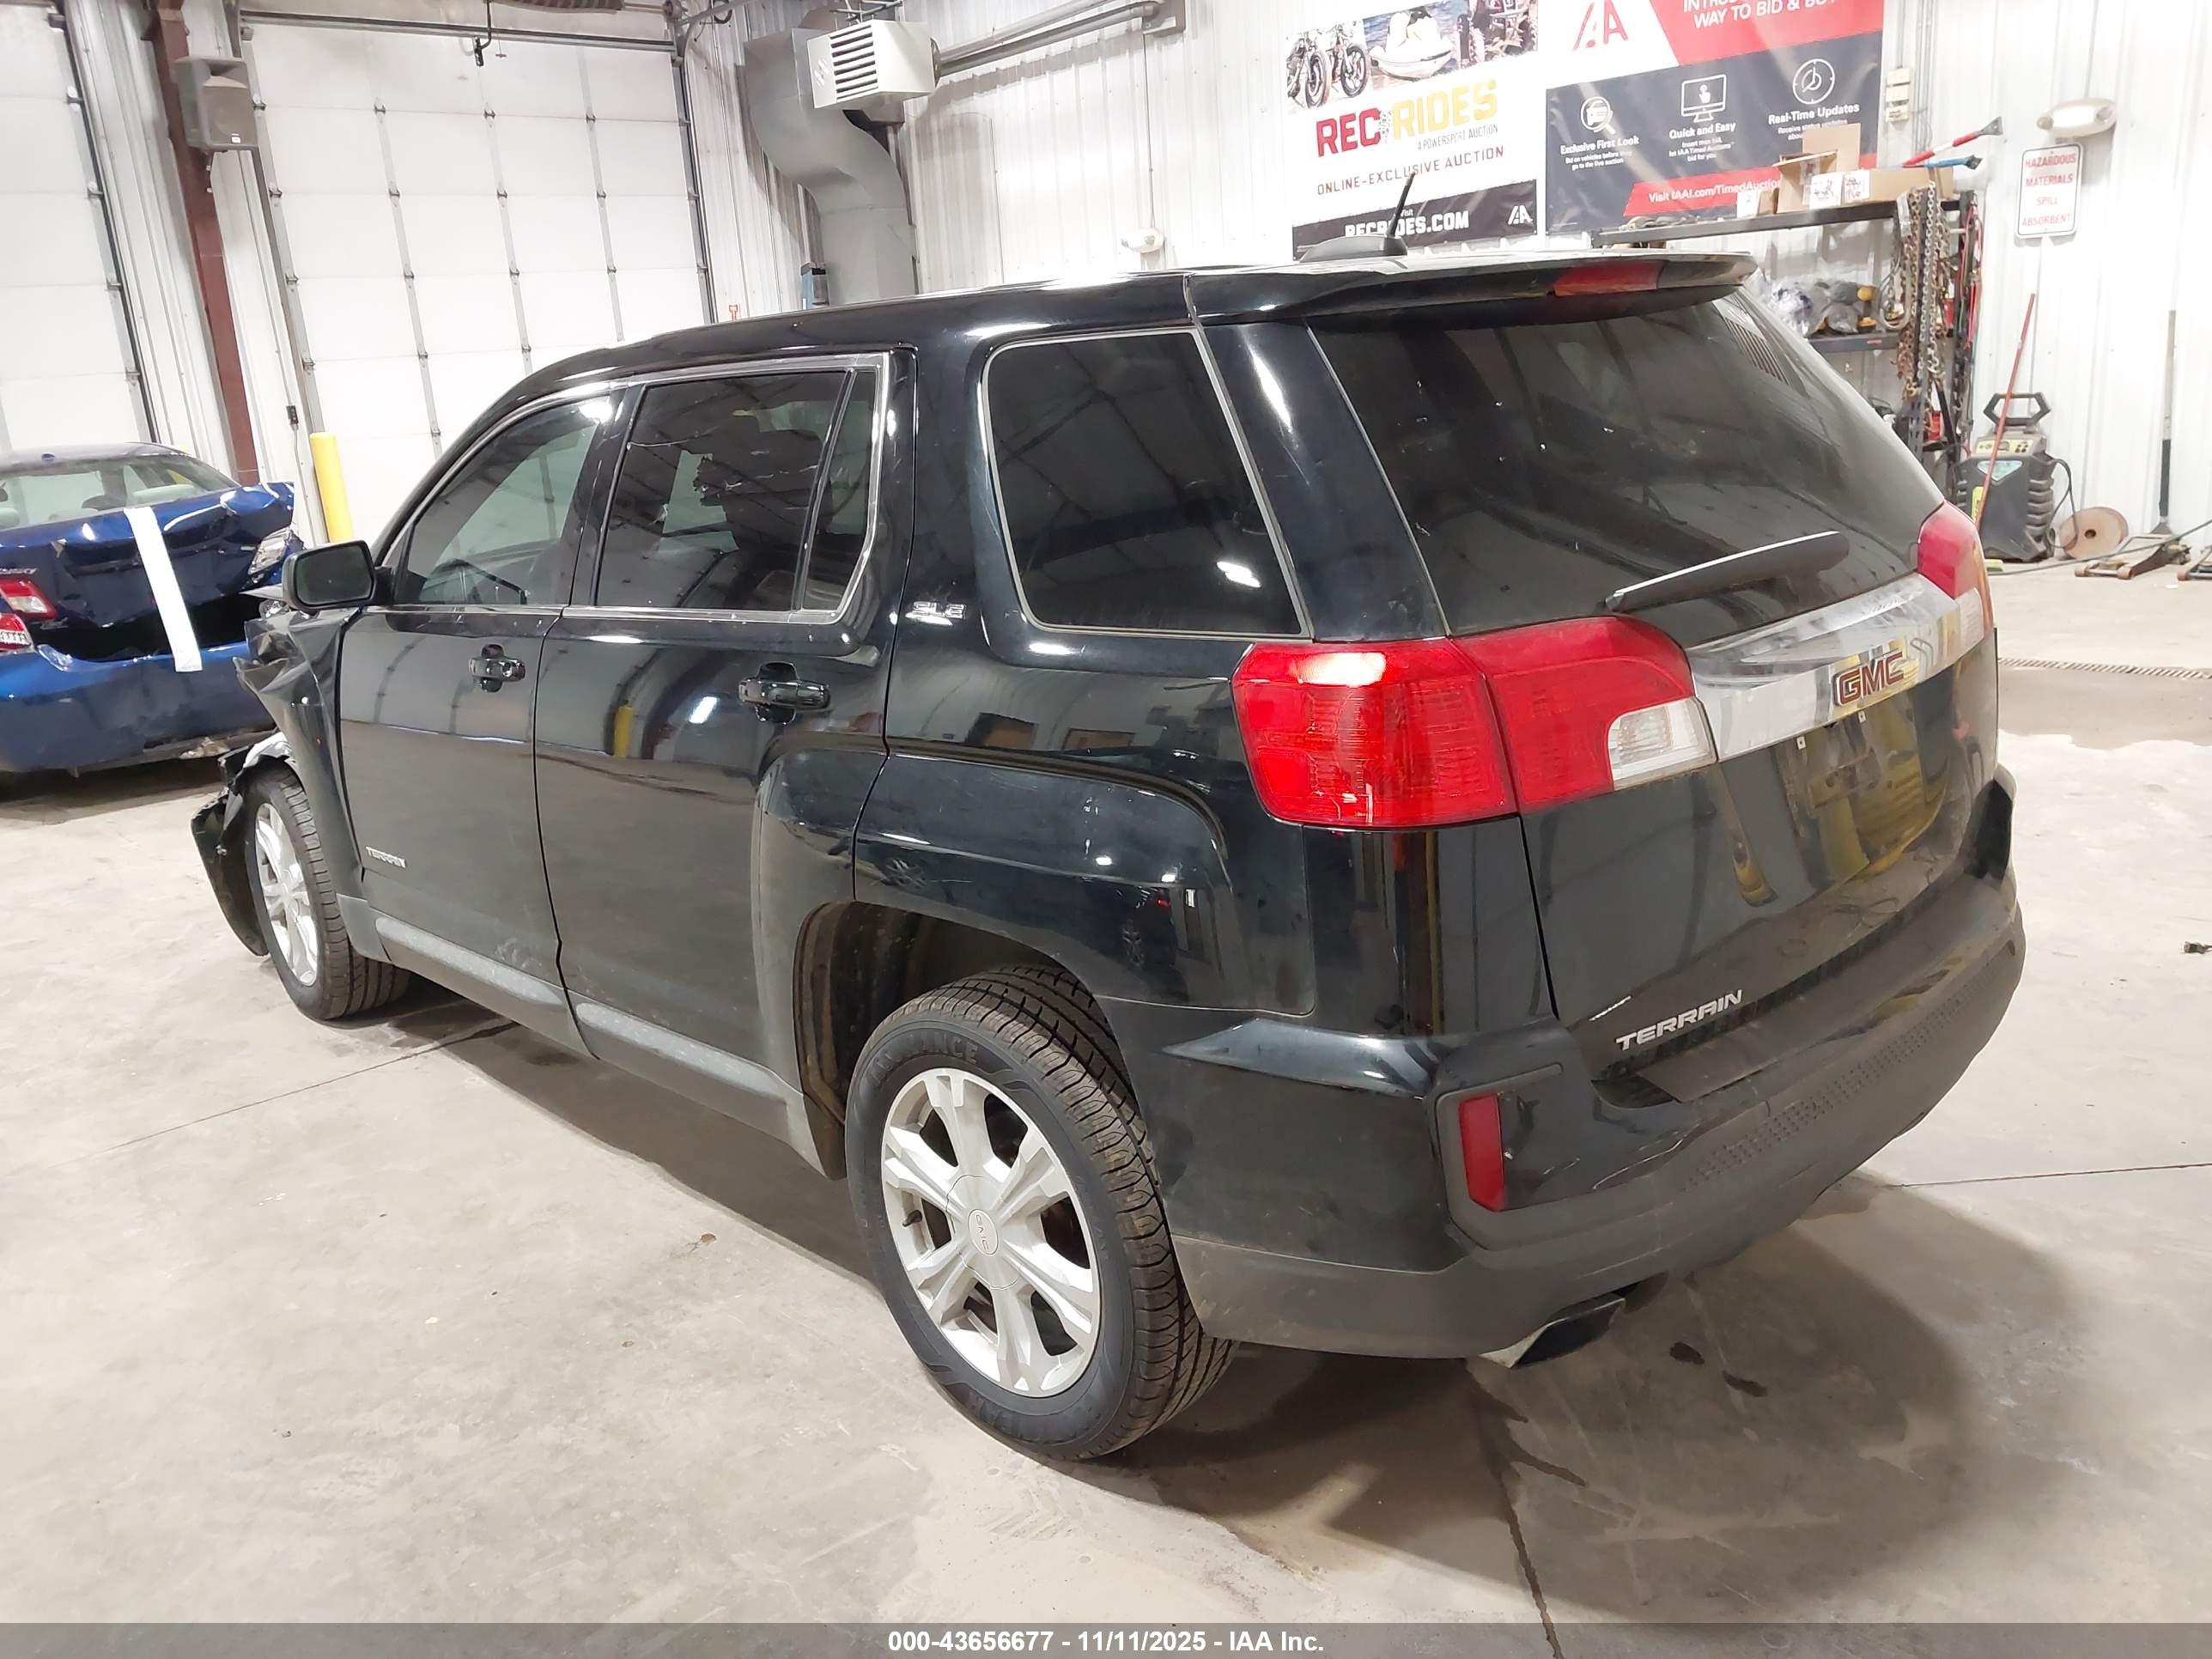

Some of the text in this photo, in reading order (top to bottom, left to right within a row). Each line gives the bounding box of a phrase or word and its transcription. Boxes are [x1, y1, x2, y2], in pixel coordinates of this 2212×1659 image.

[1693, 8, 1727, 28] WAY
[1730, 3, 1752, 21] TO
[1756, 0, 1784, 16] BID
[1316, 79, 1498, 157] REC RIDES
[1768, 104, 1860, 125] Real-Time Updates
[1468, 123, 1498, 138] AUCTION
[1668, 122, 1736, 139] Quick and Easy
[1559, 135, 1640, 155] Exclusive First Look
[2025, 154, 2076, 167] HAZARDOUS
[1316, 144, 1504, 196] ONLINE-EXCLUSIVE AUCTION
[2026, 173, 2074, 186] MATERIALS
[1648, 191, 1670, 203] Visit
[2036, 196, 2058, 206] SPILL
[2021, 214, 2071, 227] ABSORBENT
[1833, 650, 1904, 706] GMC
[1615, 988, 1742, 1051] TERRAIN
